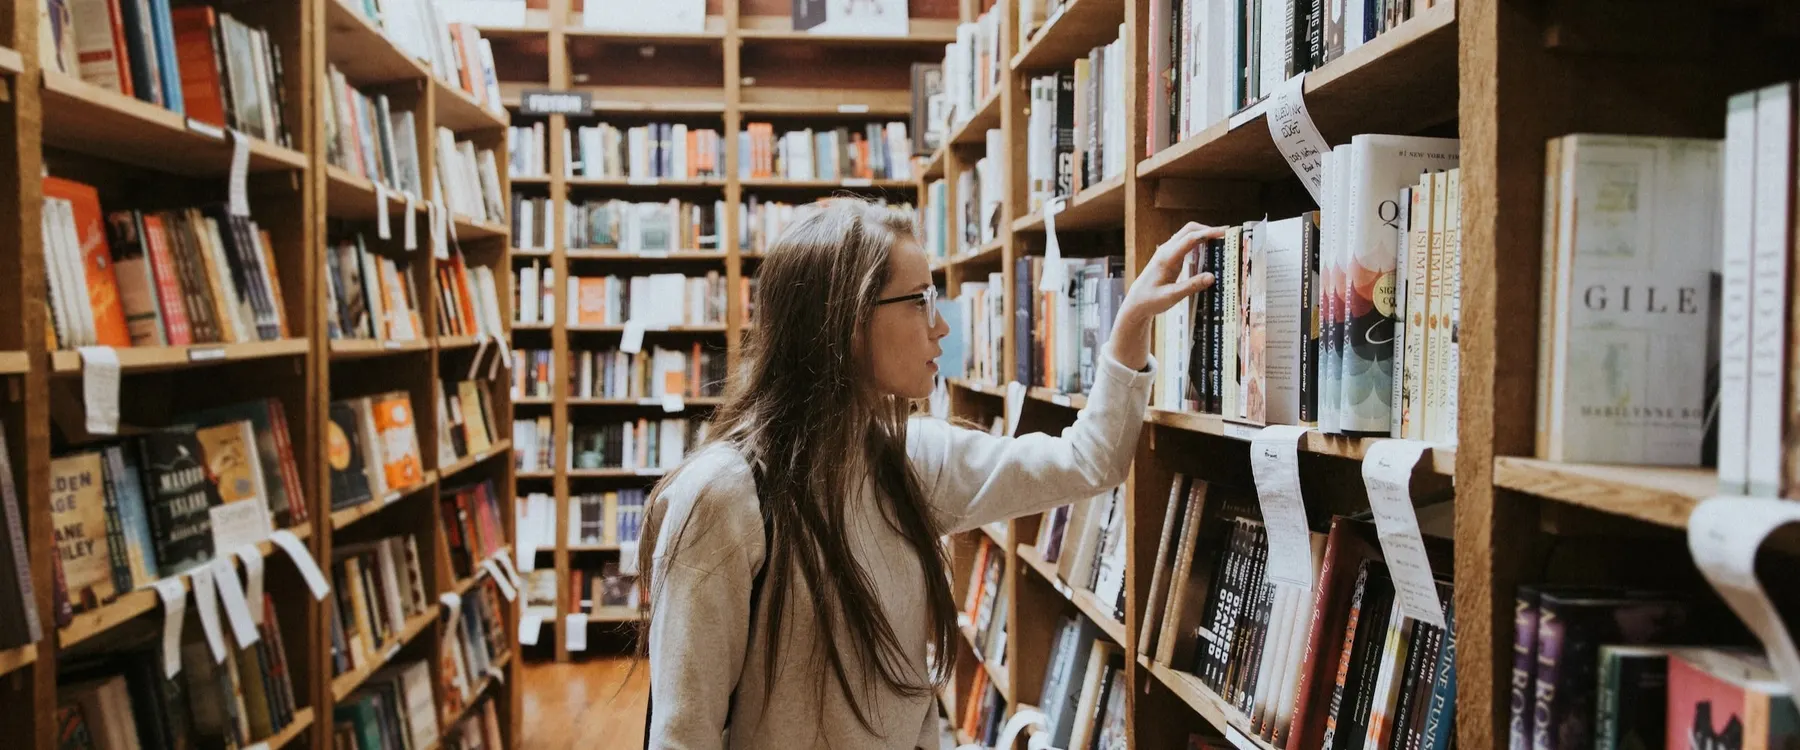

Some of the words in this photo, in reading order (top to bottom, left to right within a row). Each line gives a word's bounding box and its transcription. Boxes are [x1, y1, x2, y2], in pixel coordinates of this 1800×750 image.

[1286, 0, 1294, 35] EDING
[1311, 0, 1320, 27] DING
[1285, 37, 1293, 64] EDGE
[1311, 30, 1319, 58] EDGE
[1427, 152, 1445, 160] YORK
[1414, 230, 1426, 299] ISHMAEL
[1430, 232, 1442, 301] ISHMAEL
[1443, 229, 1455, 300] ISHMAEL
[1584, 283, 1699, 315] GILE
[1412, 333, 1420, 368] DANIEL
[1428, 336, 1436, 371] DANIEL
[1441, 336, 1449, 371] DANIEL
[1411, 369, 1419, 403] QUINN
[1427, 373, 1435, 408] QUINN
[1439, 373, 1447, 408] QUINN
[52, 470, 92, 493] DEN
[1244, 560, 1258, 617] IMPERFECTIONISTS
[1249, 563, 1264, 620] IMPERFECTIONISTS
[1318, 560, 1330, 596] Devil
[1315, 592, 1321, 605] in
[1214, 591, 1234, 660] OTARED
[1220, 595, 1240, 664] OTARED
[1304, 604, 1320, 663] Jerusalem
[1410, 638, 1420, 671] RAKHA
[1419, 658, 1428, 680] CAME
[1427, 662, 1435, 684] CAME
[1353, 691, 1362, 722] Childhood
[1360, 695, 1369, 727] Childhood
[1424, 692, 1445, 750] PUNIS
[1413, 732, 1421, 750] MAR
